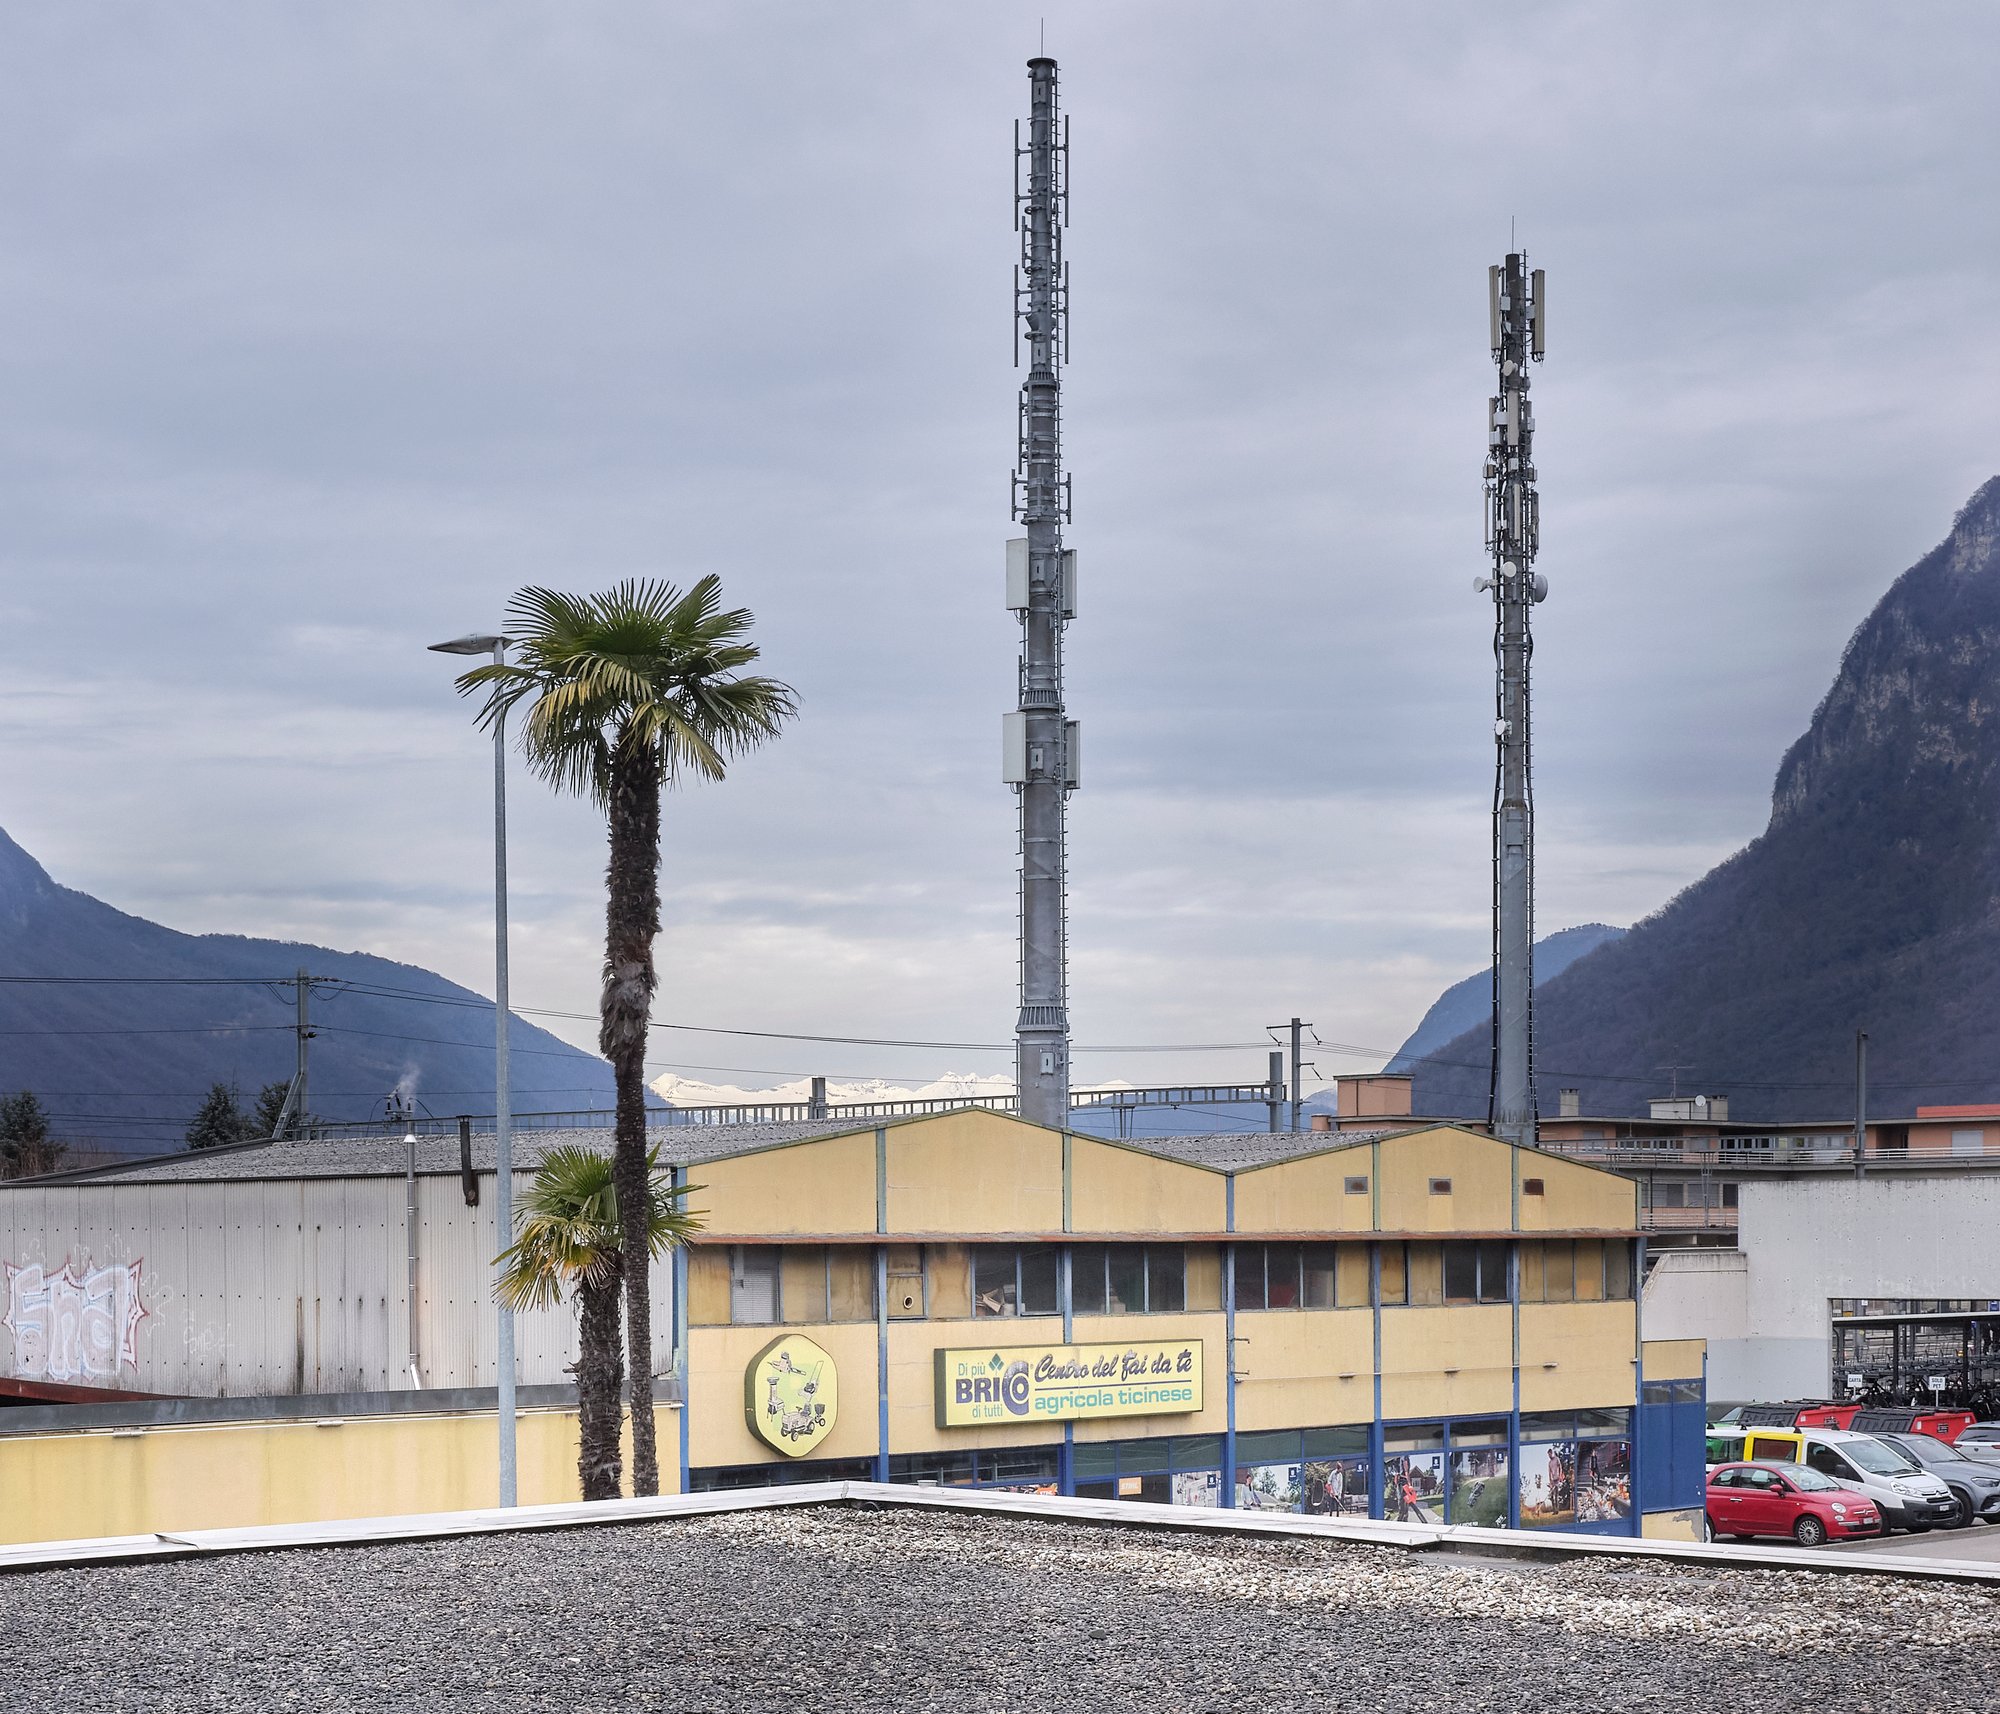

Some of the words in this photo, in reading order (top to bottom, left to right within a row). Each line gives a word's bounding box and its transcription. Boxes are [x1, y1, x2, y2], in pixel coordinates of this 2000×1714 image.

[958, 1363, 968, 1376] Di
[971, 1362, 986, 1378] più
[1035, 1353, 1089, 1383] Centro
[1092, 1354, 1119, 1378] del
[1121, 1349, 1148, 1382] fai
[1151, 1352, 1172, 1375] da
[1177, 1349, 1192, 1374] te
[956, 1361, 1029, 1415] BRICO
[1035, 1389, 1114, 1414] agricola
[1118, 1387, 1192, 1405] ticinese
[972, 1405, 981, 1418] di
[985, 1404, 1003, 1418] tutti
